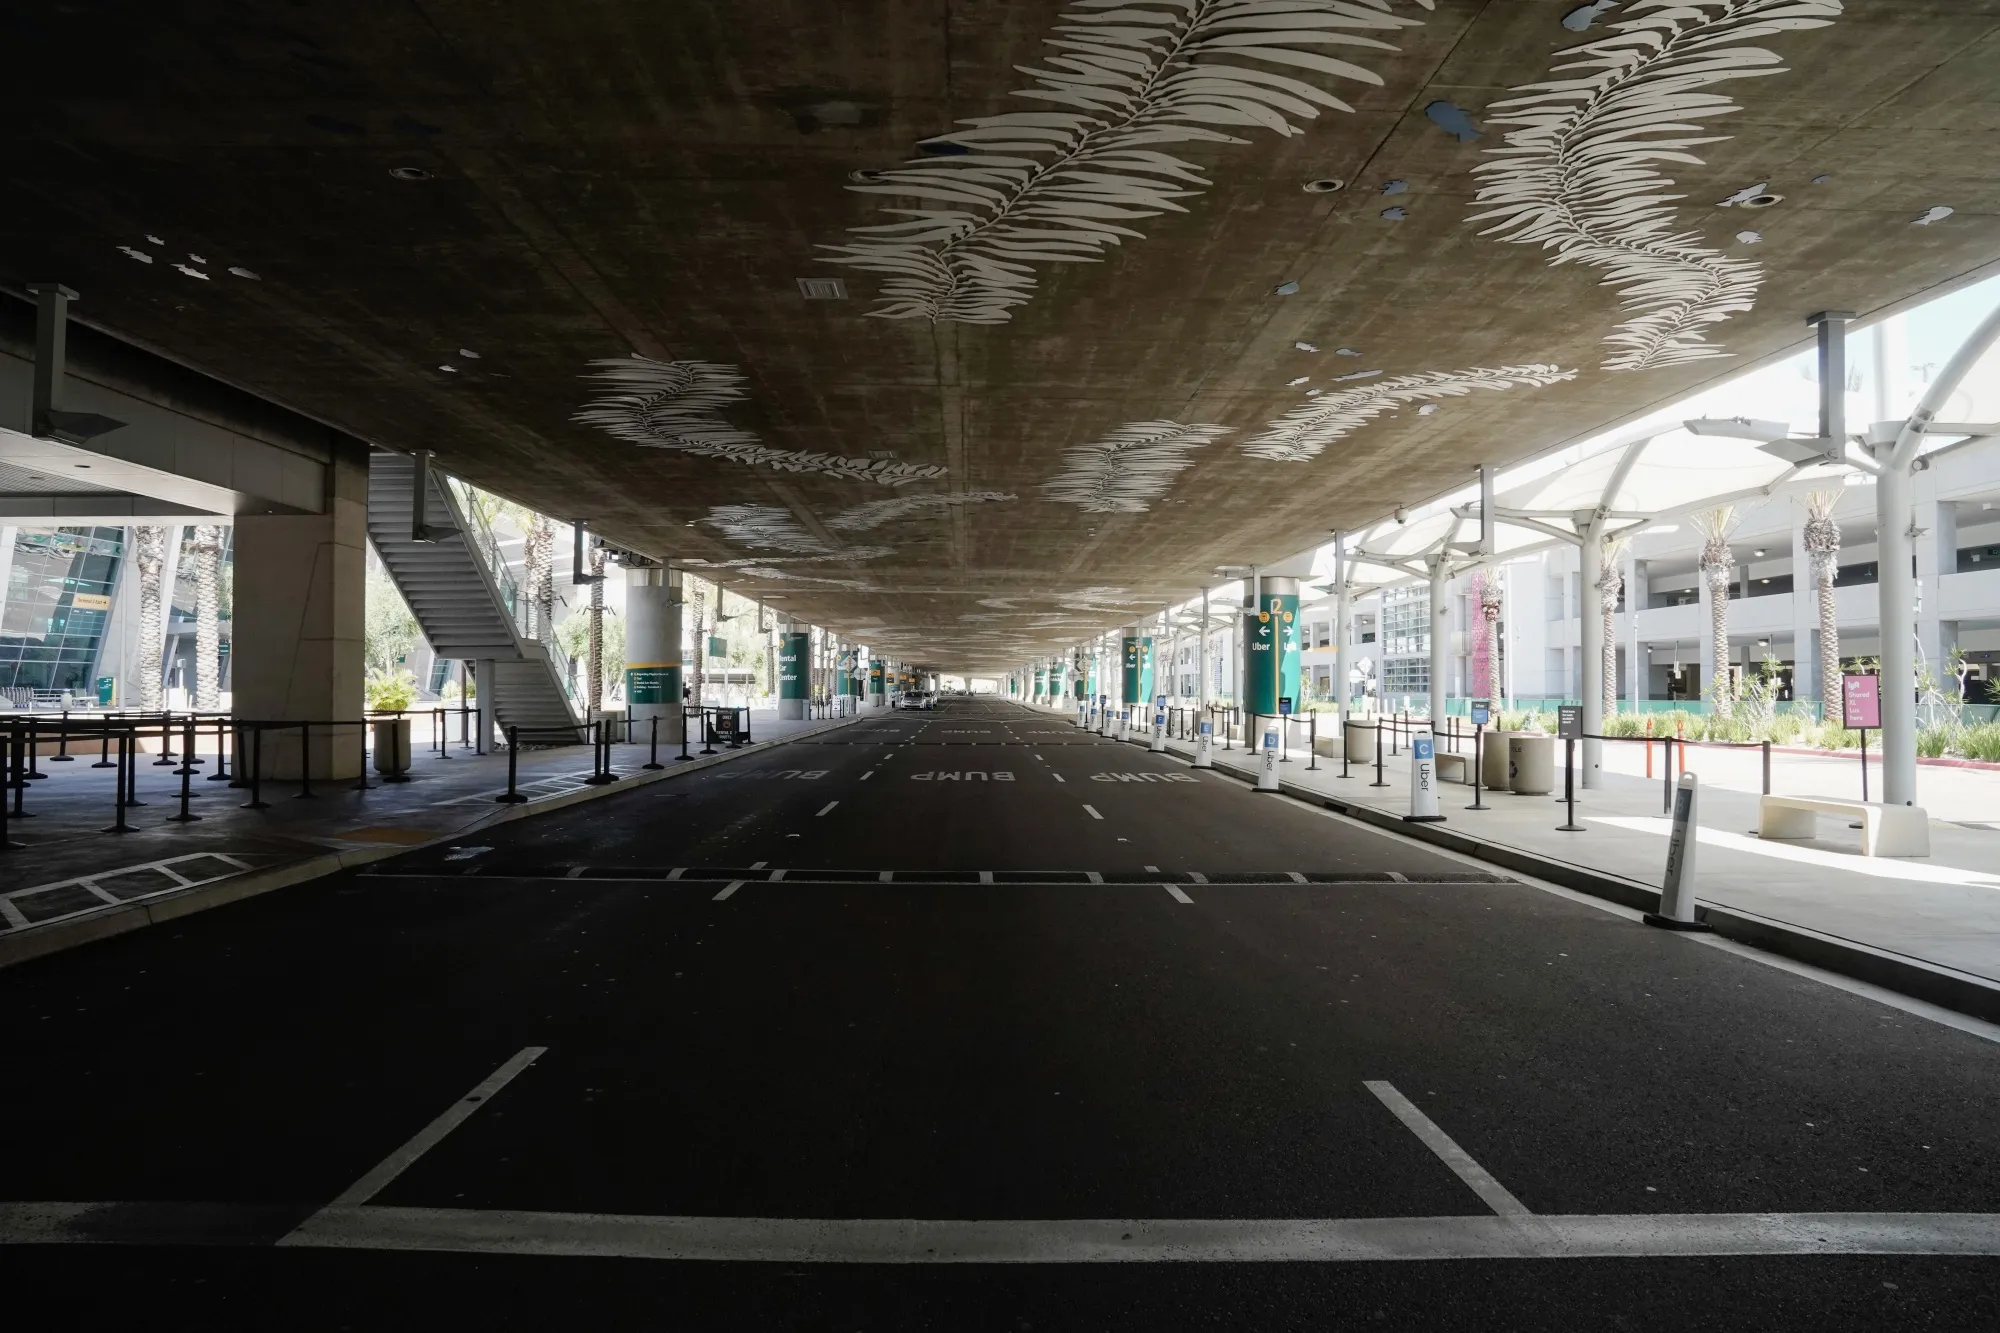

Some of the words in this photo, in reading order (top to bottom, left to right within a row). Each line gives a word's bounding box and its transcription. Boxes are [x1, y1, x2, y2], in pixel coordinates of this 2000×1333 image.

[1252, 642, 1270, 650] Uber
[1848, 682, 1860, 690] lyft
[1419, 744, 1428, 754] C
[910, 771, 1016, 782] BUMP
[1090, 772, 1202, 783] BUMP
[1420, 764, 1429, 791] Uber
[1668, 829, 1680, 876] Uber
